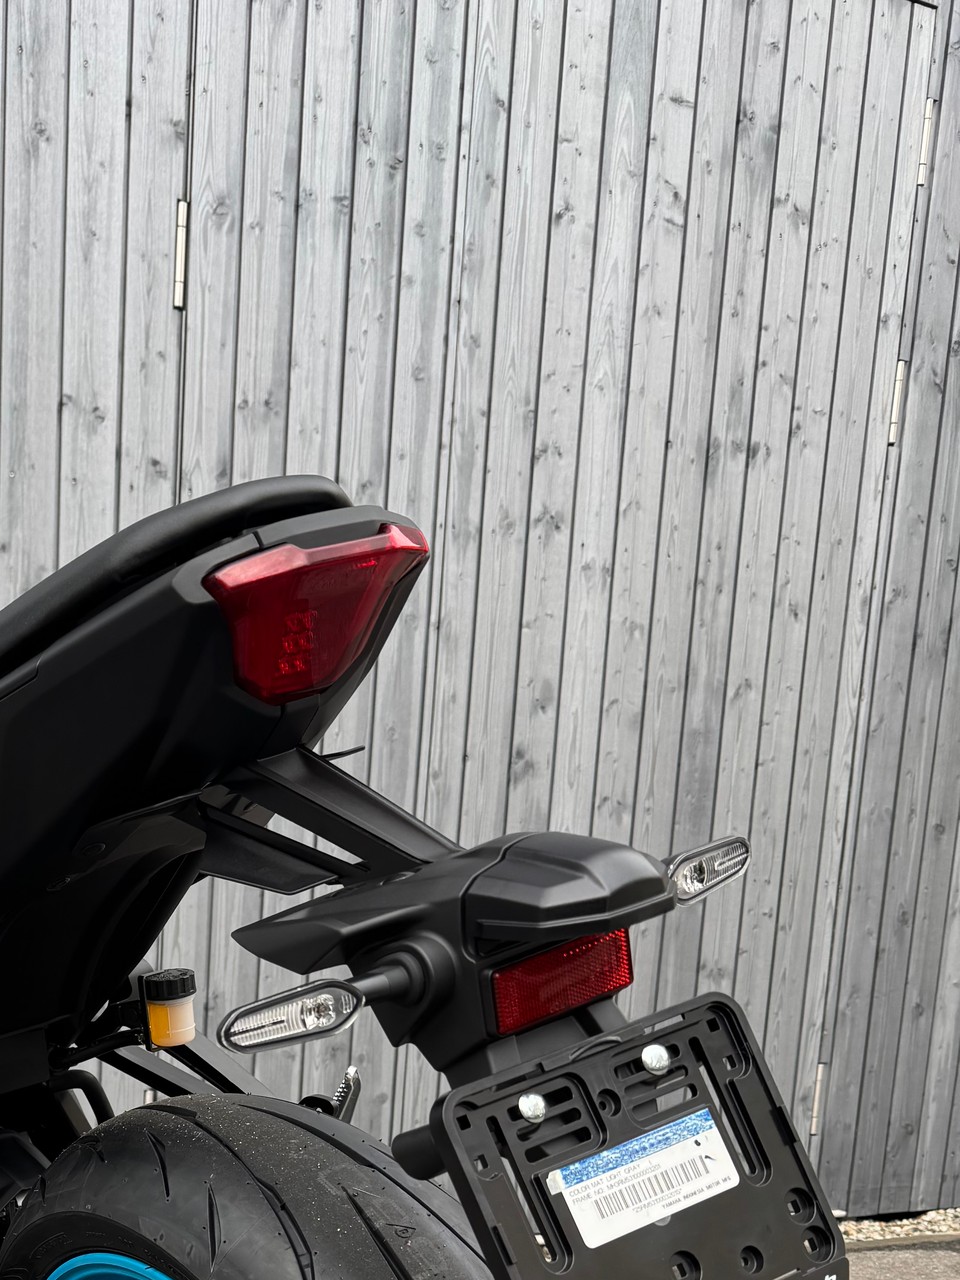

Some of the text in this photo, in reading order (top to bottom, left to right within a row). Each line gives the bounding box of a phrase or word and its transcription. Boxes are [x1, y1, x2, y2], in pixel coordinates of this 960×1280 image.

[569, 1185, 590, 1197] COLOR
[571, 1193, 593, 1205] FRAME
[661, 1197, 682, 1209] YAMAHA
